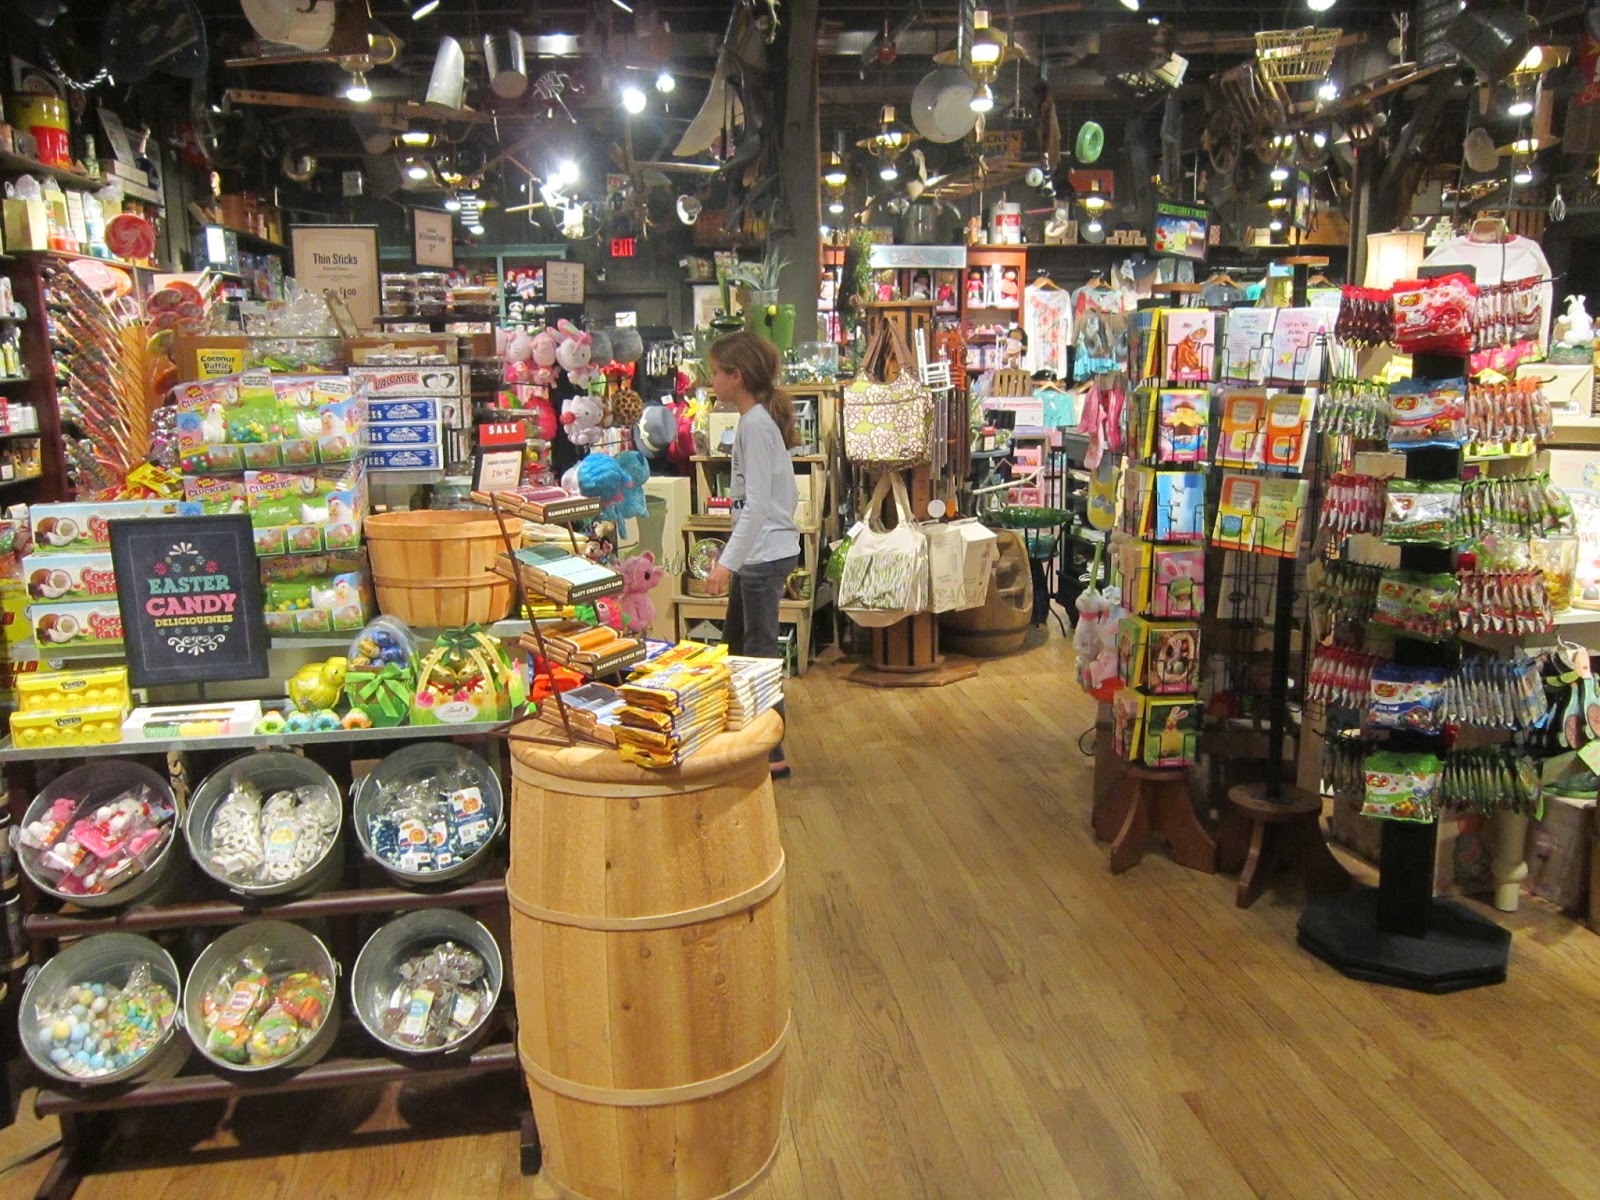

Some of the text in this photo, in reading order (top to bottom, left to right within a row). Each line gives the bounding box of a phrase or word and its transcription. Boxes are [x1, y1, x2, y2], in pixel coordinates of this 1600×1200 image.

[611, 238, 634, 257] EXIT
[313, 253, 358, 265] Thin Sticks
[204, 362, 233, 371] Patties
[488, 423, 518, 435] SALE
[188, 483, 231, 497] CLUCKERS
[249, 480, 291, 493] CLUCKERS
[548, 506, 575, 517] HAMMOND'S
[148, 574, 231, 595] EASTER
[572, 590, 586, 598] TASTY
[586, 584, 612, 594] CHOCOLATE
[146, 593, 237, 616] CANDY
[154, 614, 234, 628] DELICIOUSNESS
[622, 652, 635, 661] SINCE
[59, 680, 87, 690] Peeps
[54, 716, 82, 726] Peeps
